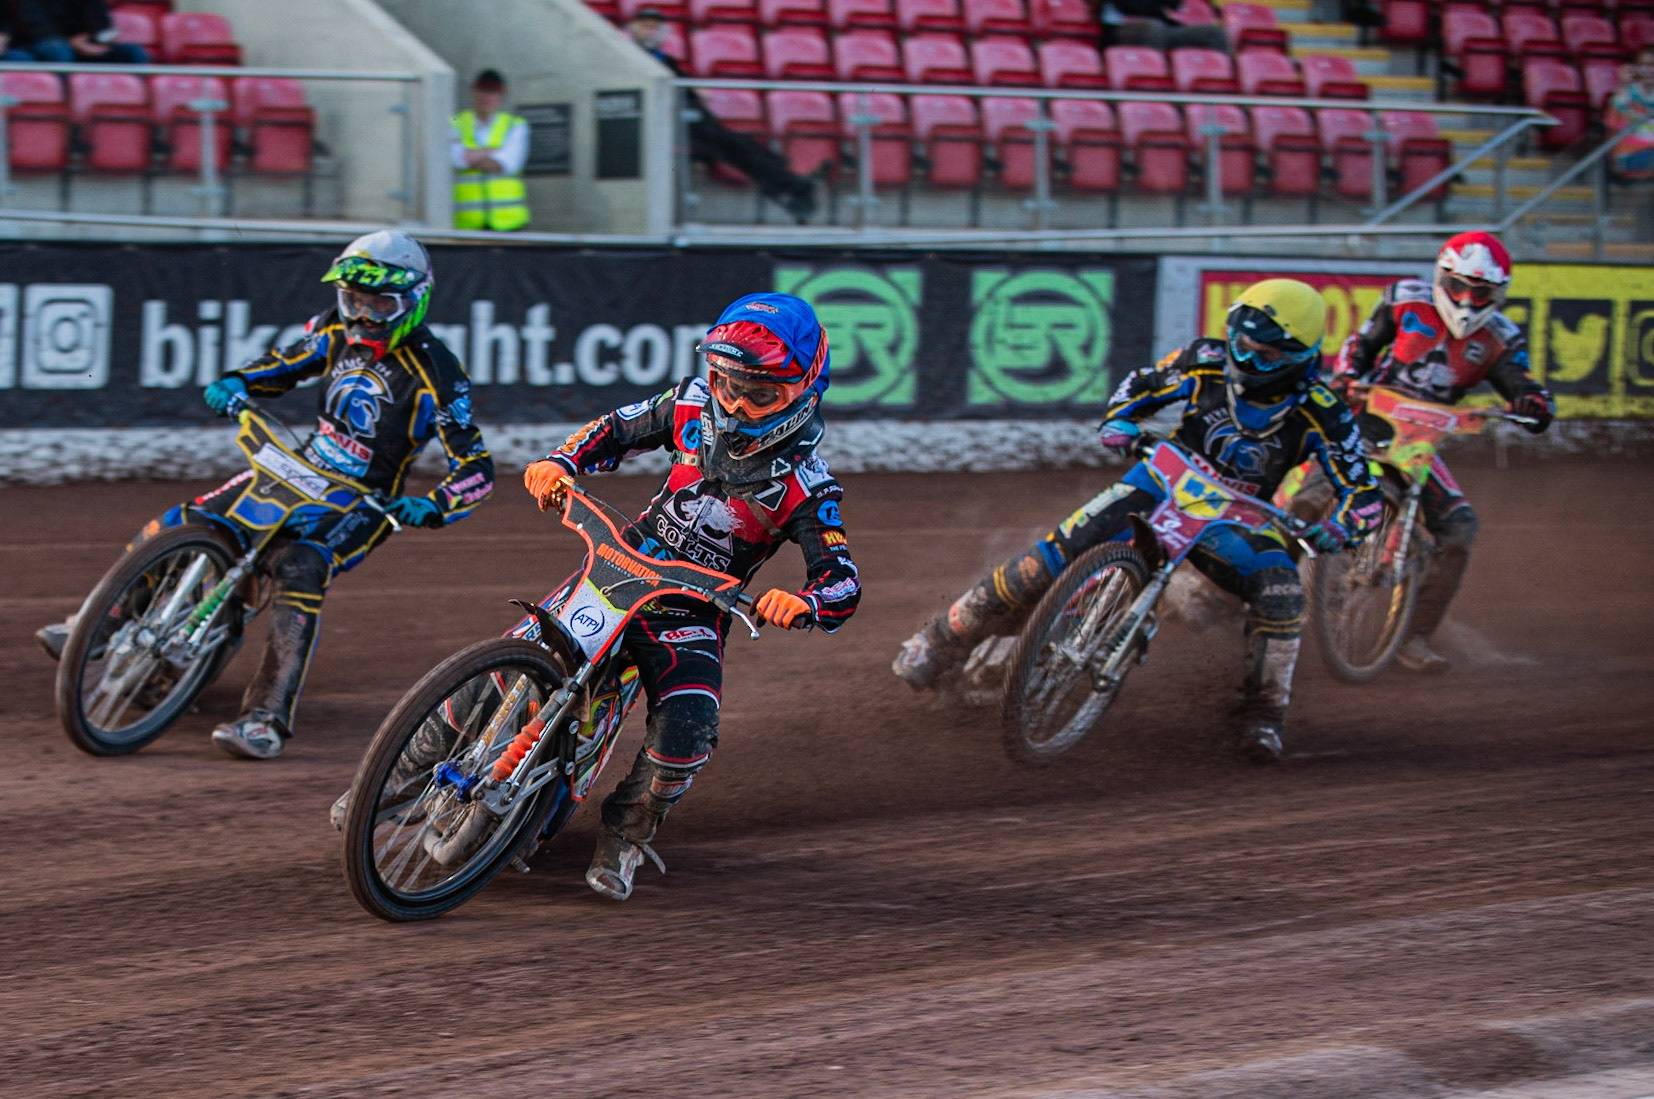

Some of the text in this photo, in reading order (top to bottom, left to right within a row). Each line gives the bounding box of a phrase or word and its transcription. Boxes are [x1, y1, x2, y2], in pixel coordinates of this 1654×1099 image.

[596, 542, 662, 587] MOTORVATION
[656, 513, 731, 573] COLTS
[574, 613, 600, 631] ATPI
